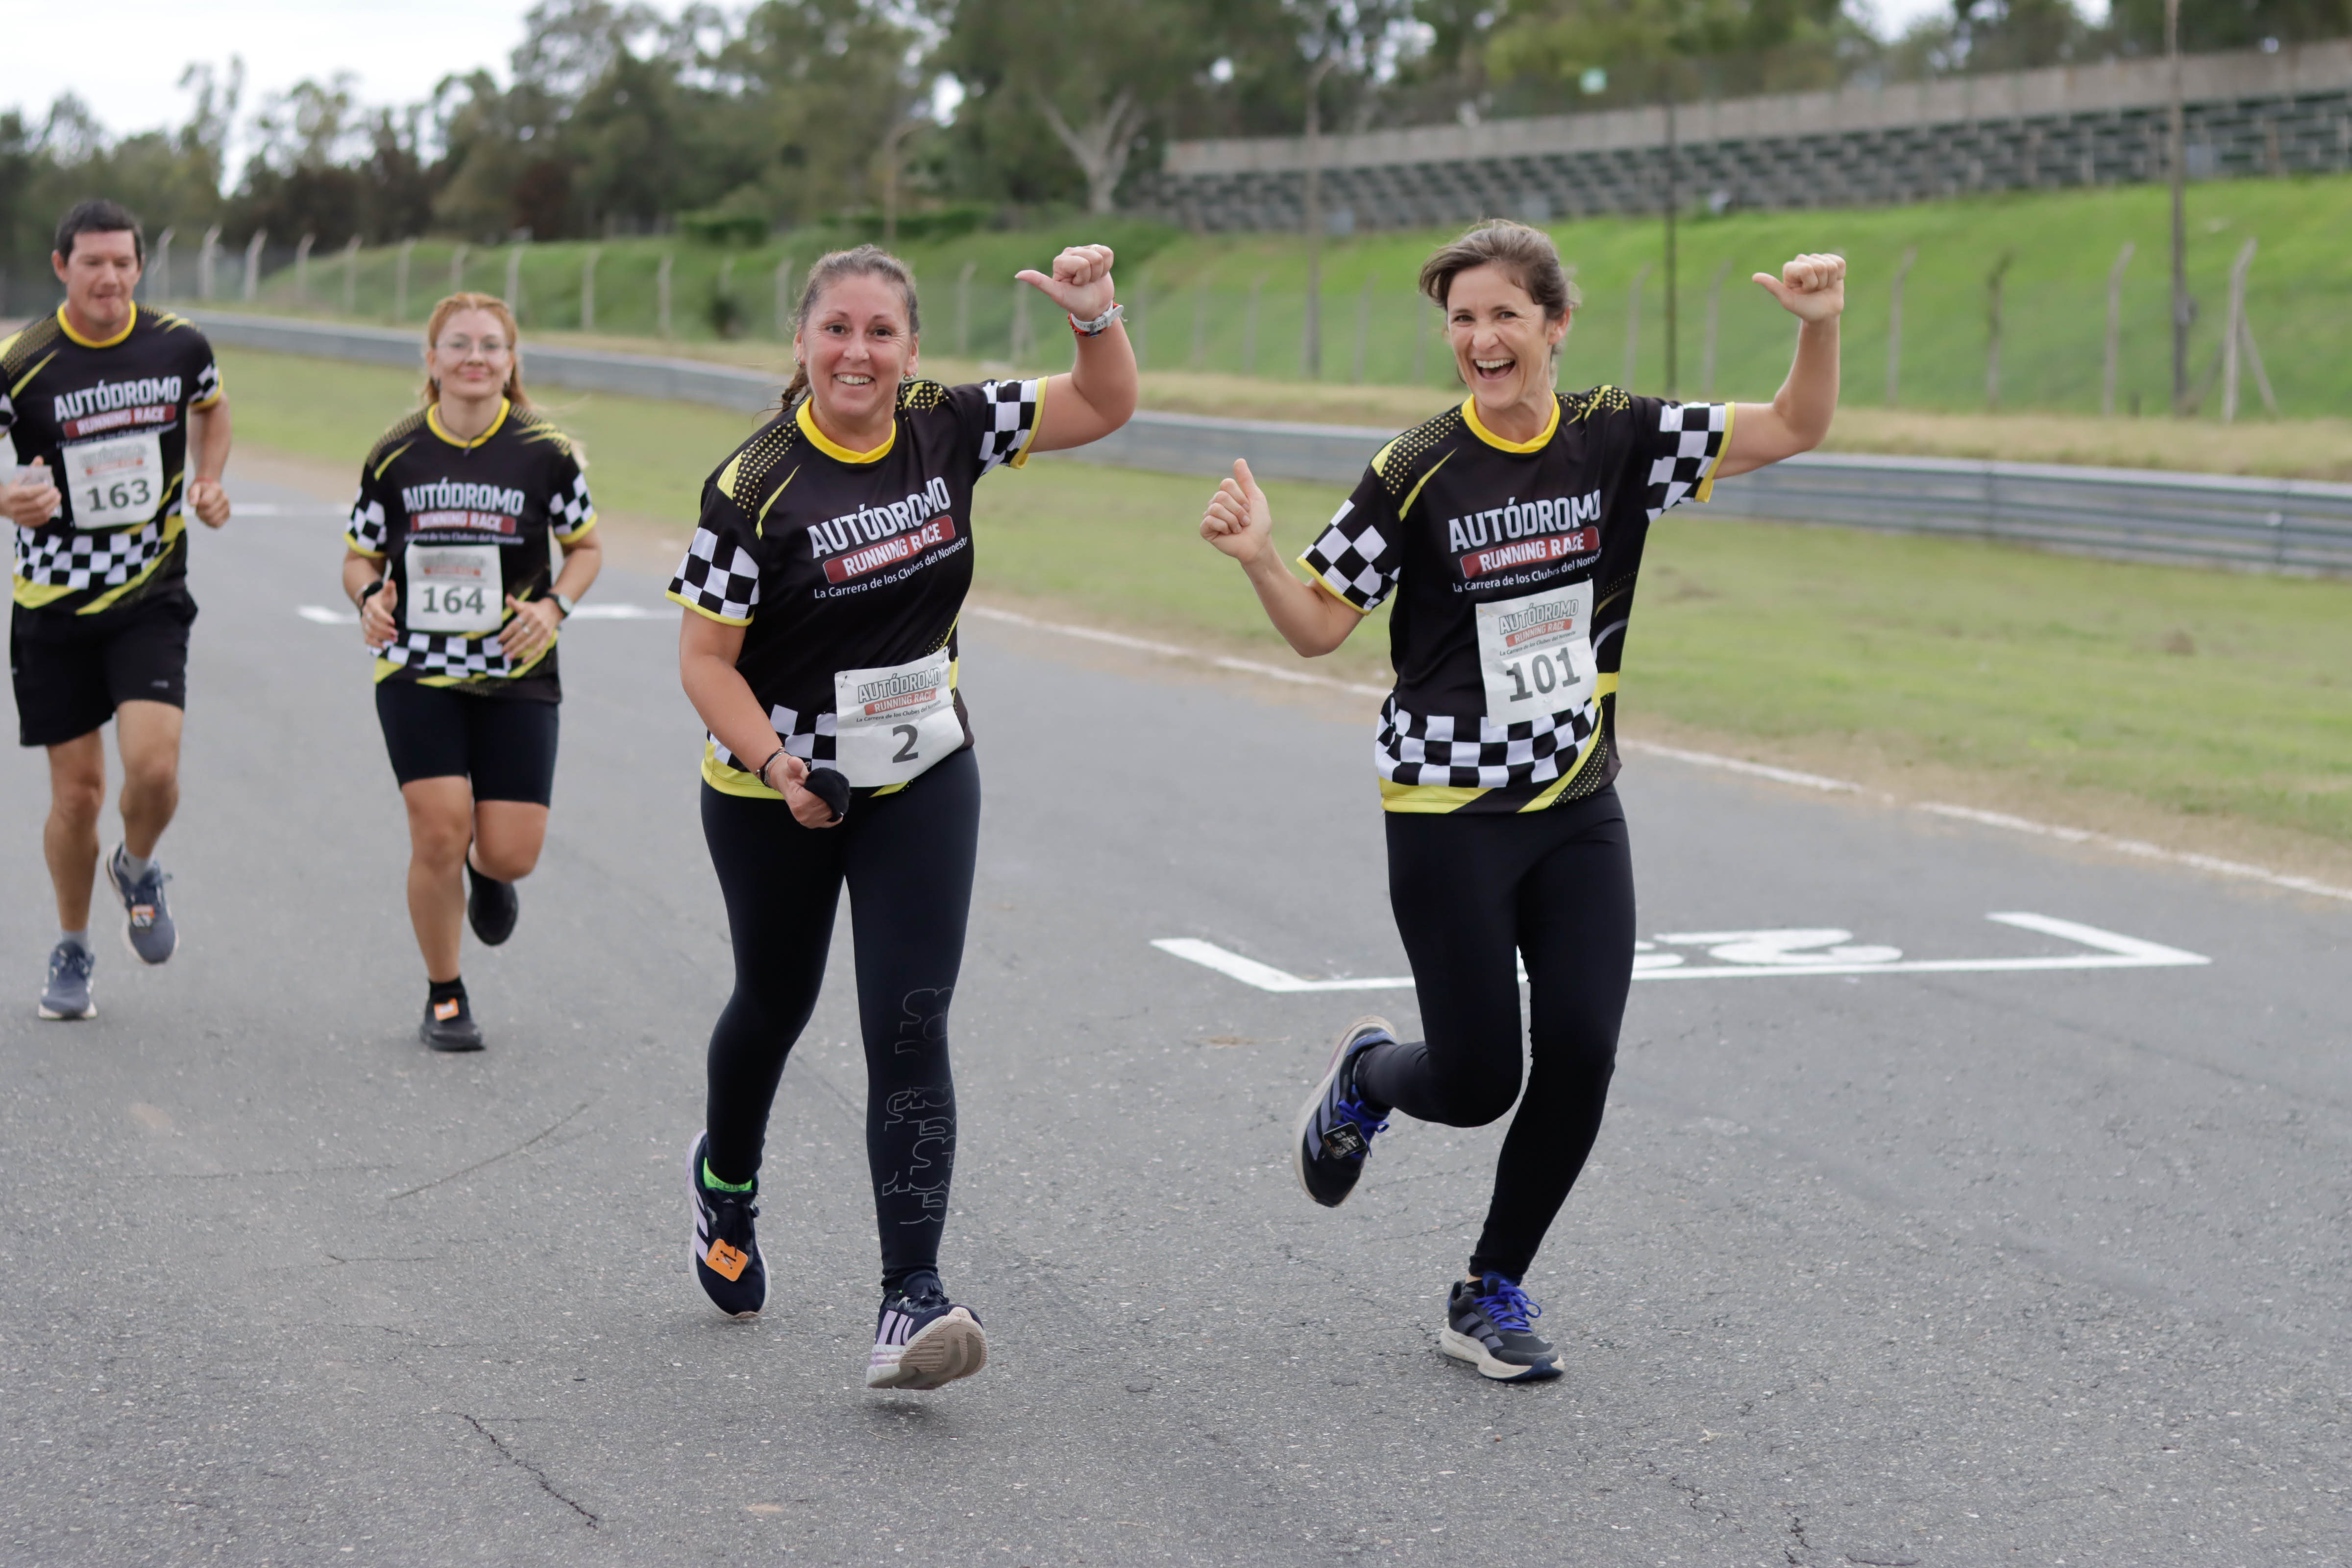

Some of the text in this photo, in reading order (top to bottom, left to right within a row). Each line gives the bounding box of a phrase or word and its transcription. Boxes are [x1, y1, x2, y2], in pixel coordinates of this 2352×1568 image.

[54, 376, 182, 422] AUTÓDROMO
[133, 406, 166, 423] RACE
[87, 478, 150, 512] 163
[402, 476, 525, 516] AUTÓDROMO
[469, 511, 503, 532] RACE
[807, 477, 951, 559] AUTÓDROMO
[1448, 489, 1601, 553] AUTÓDROMO
[842, 523, 943, 577] RUNNING RACE
[1478, 533, 1585, 572] RUNNING RACE
[814, 589, 826, 598] La
[829, 582, 868, 597] Carrera
[870, 578, 882, 588] de
[884, 575, 897, 585] los
[898, 563, 924, 580] Clubes
[925, 553, 938, 565] del
[1452, 583, 1463, 592] La
[1465, 578, 1500, 590] Carrera
[1502, 575, 1514, 586] de
[1516, 574, 1530, 584] los
[1531, 568, 1560, 582] Clubes
[1562, 561, 1575, 573] del
[422, 587, 486, 615] 164
[1499, 599, 1579, 635] AUTÓDROMO
[1507, 646, 1522, 655] Carrera
[1514, 621, 1566, 644] RUNNING RACE
[858, 667, 941, 704] AUTÓDROMO
[1506, 647, 1581, 702] 101
[874, 695, 912, 712] RUNNING
[914, 691, 932, 703] RACE
[892, 724, 919, 763] 2
